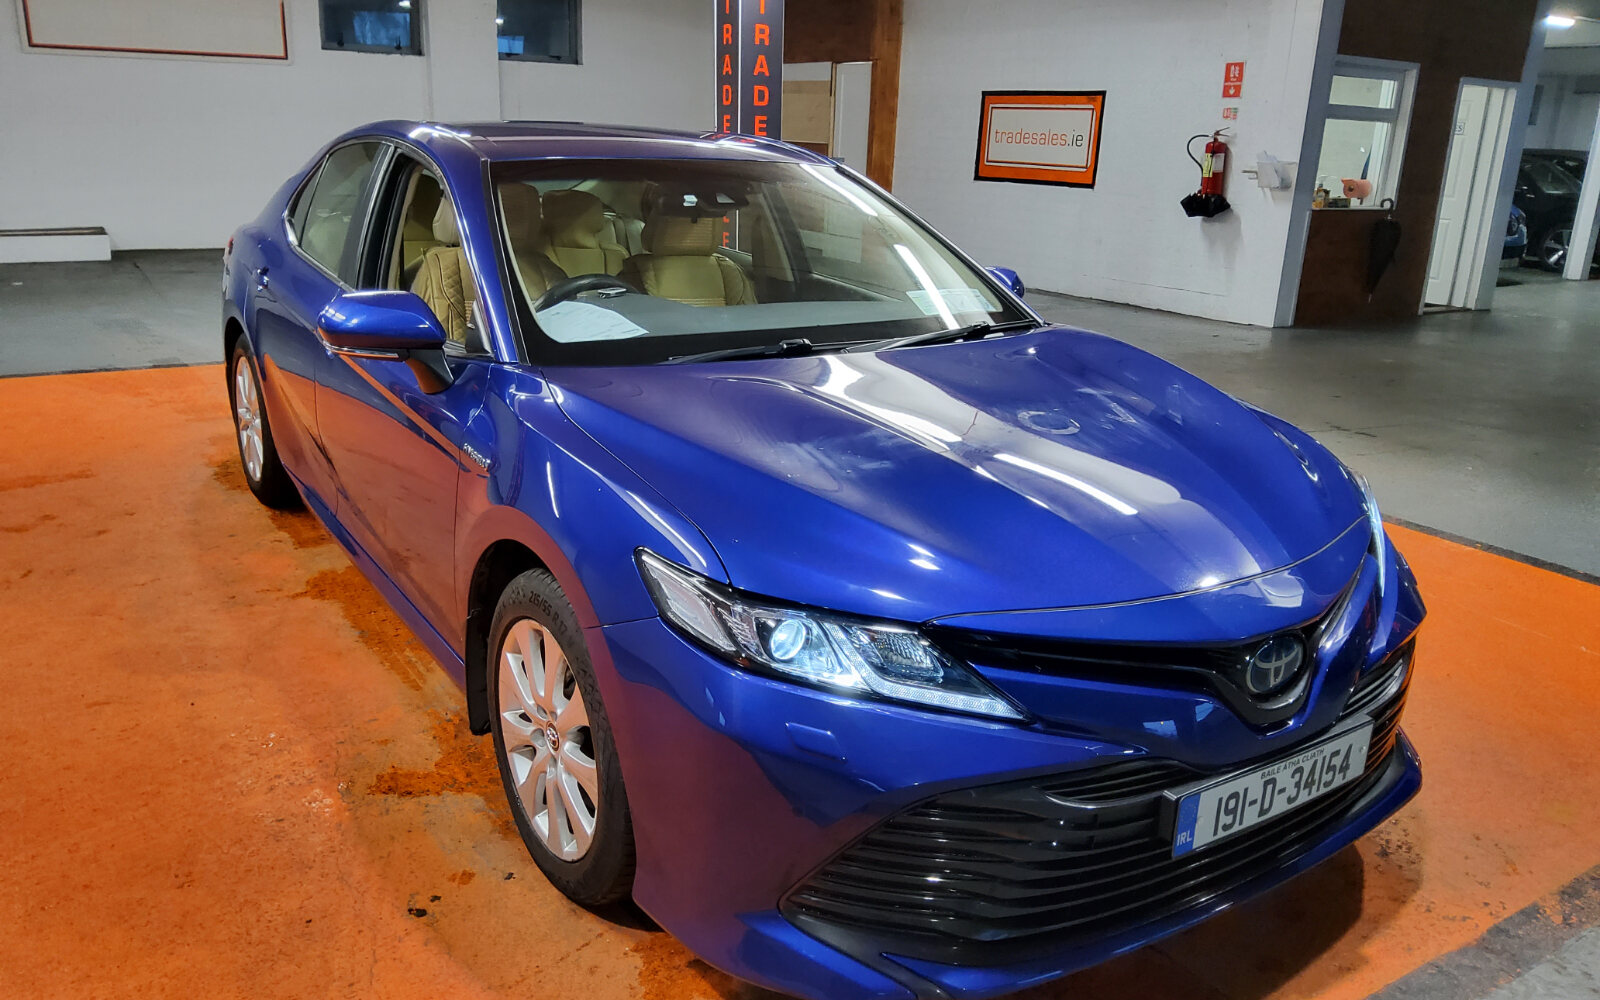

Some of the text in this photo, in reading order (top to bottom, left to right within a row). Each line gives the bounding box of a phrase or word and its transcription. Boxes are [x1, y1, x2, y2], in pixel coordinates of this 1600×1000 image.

[994, 128, 1084, 148] tradesales.ie
[1213, 743, 1353, 837] 191-D-34154
[1176, 831, 1193, 847] IRL
